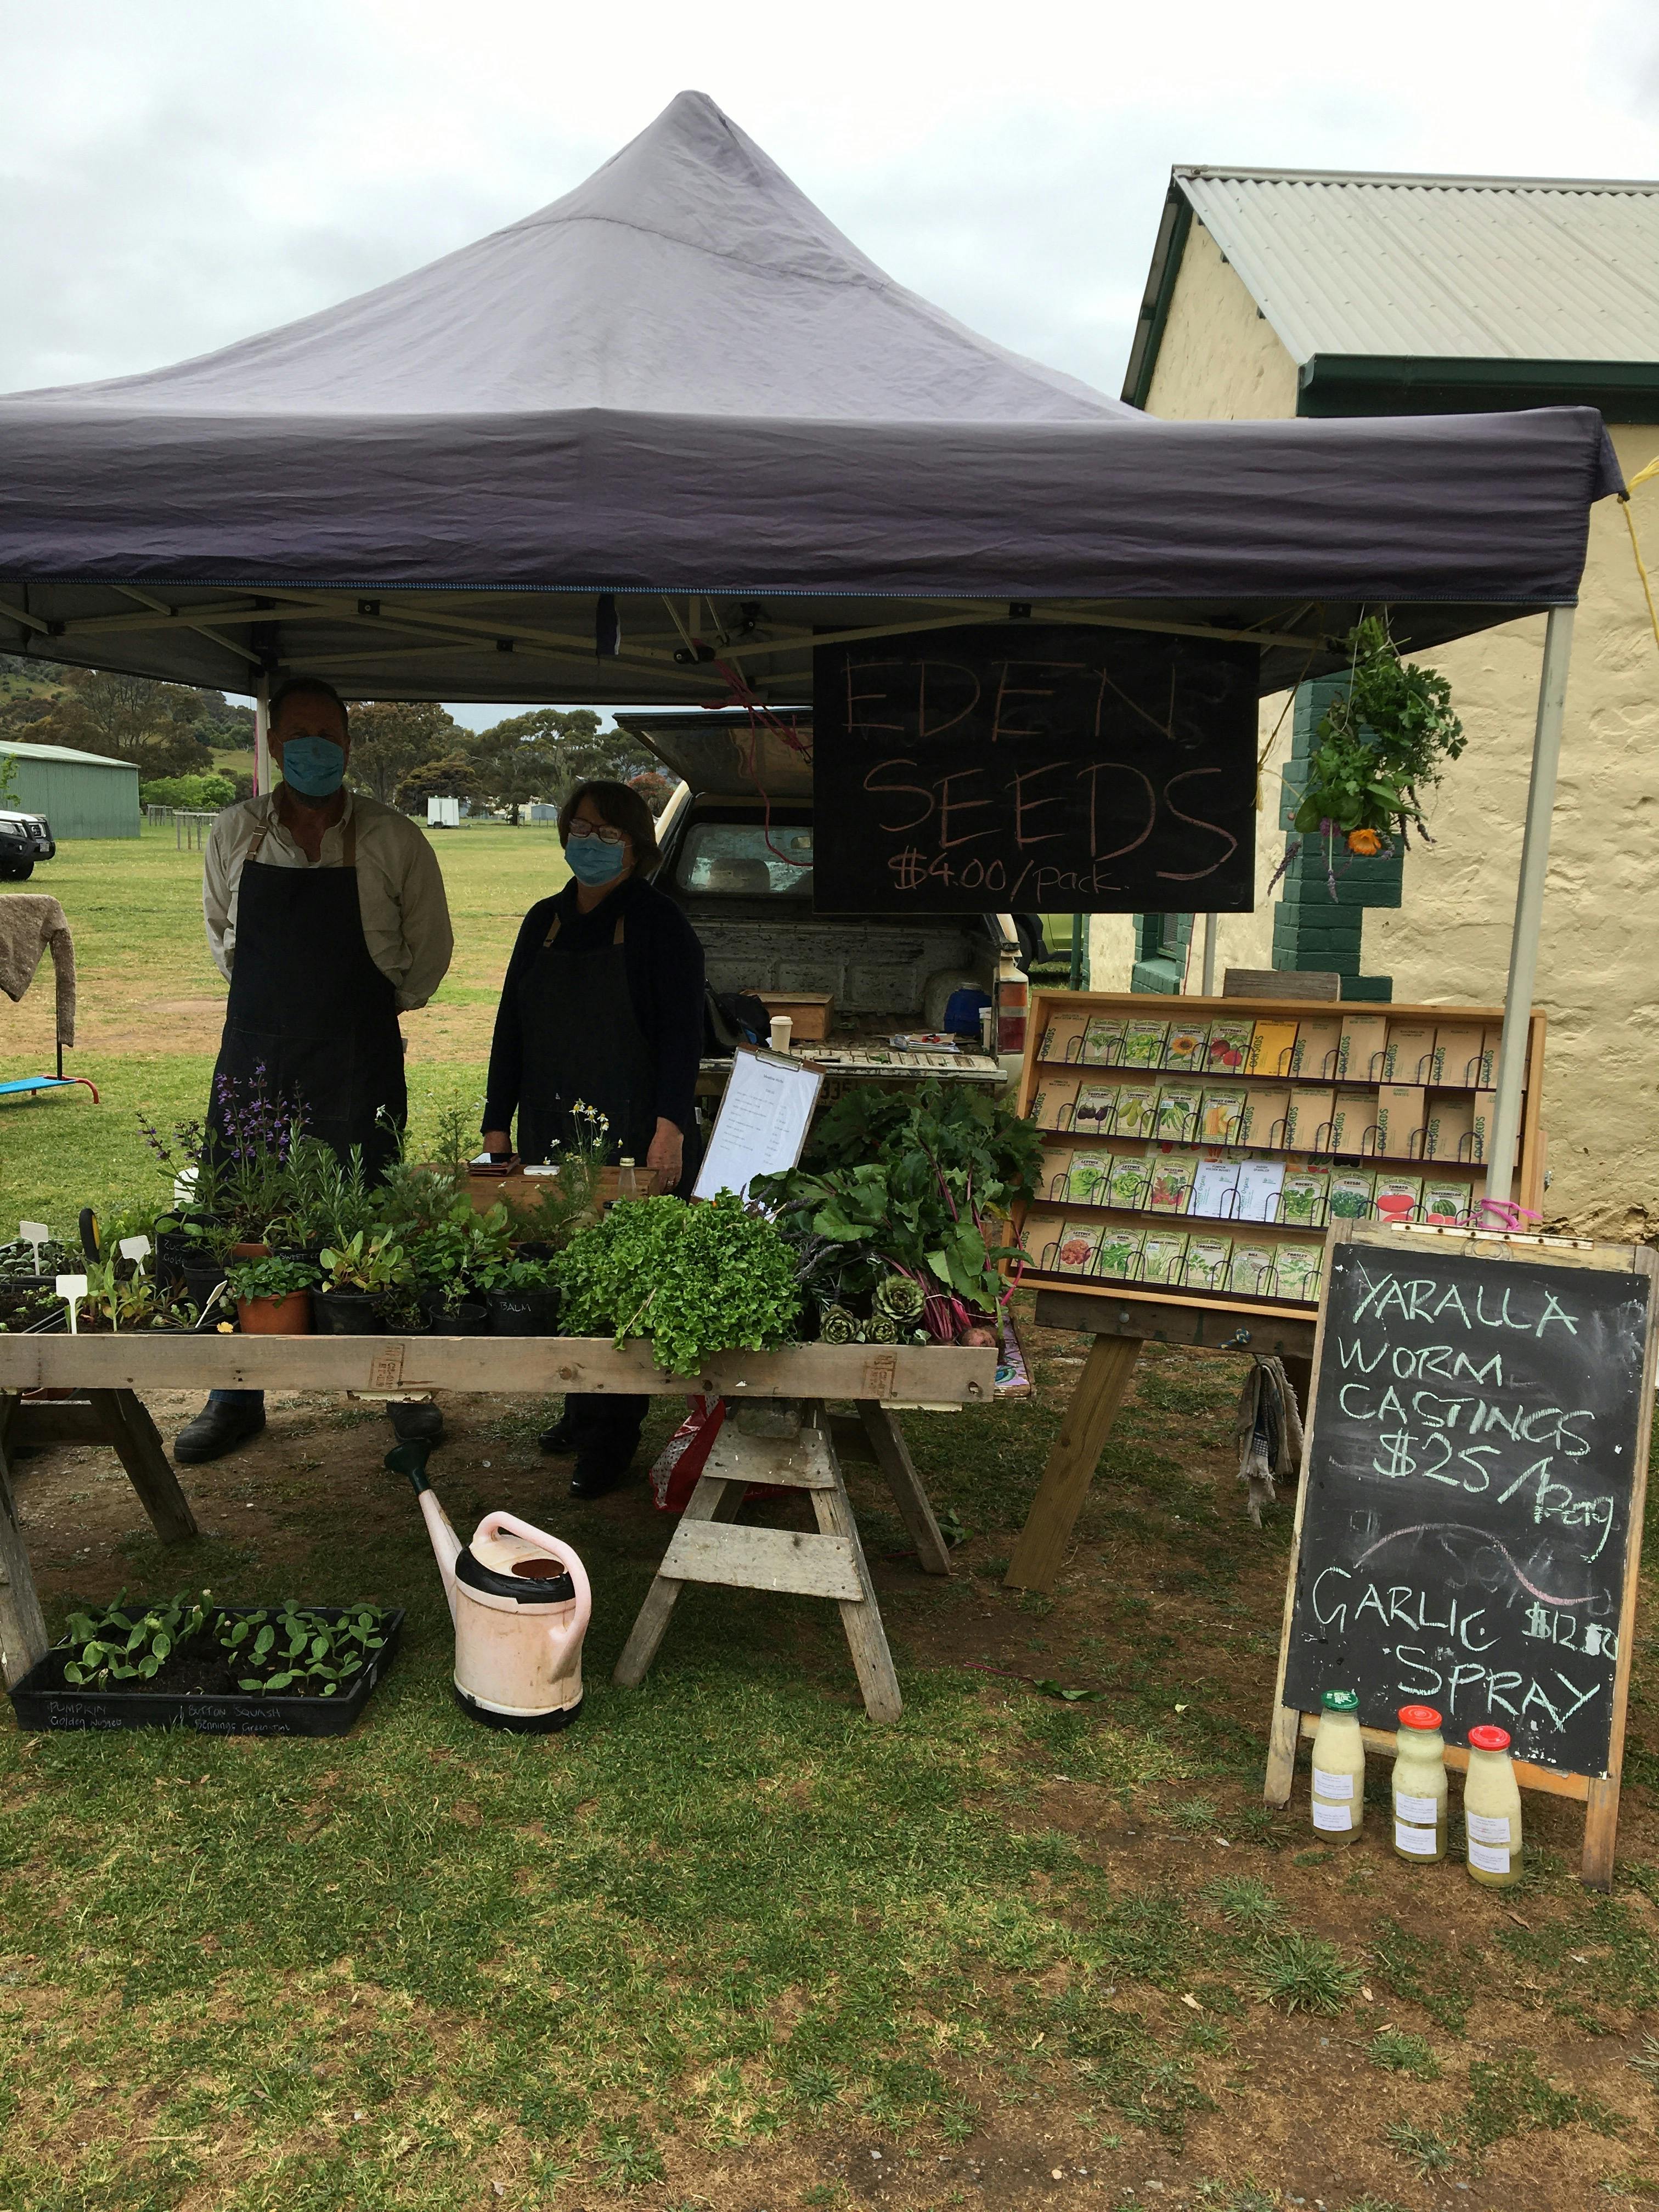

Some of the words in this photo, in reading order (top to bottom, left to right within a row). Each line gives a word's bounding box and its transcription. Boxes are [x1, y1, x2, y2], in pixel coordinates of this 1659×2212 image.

[841, 653, 1175, 741] EDEN
[864, 759, 1238, 881] SEEDS
[280, 1252, 308, 1261] SWEET
[500, 1301, 532, 1312] BALM
[1352, 1260, 1579, 1338] YARALLA
[1338, 1336, 1503, 1387] WORM
[1339, 1383, 1596, 1457] CASTINGS
[1312, 1566, 1502, 1652] GARLIC
[49, 1701, 106, 1716] PUMPKIN
[188, 1705, 226, 1718] BUTTON
[235, 1705, 281, 1718] SQUASH
[1396, 1645, 1600, 1733] SPRAY
[49, 1716, 86, 1729] Golden
